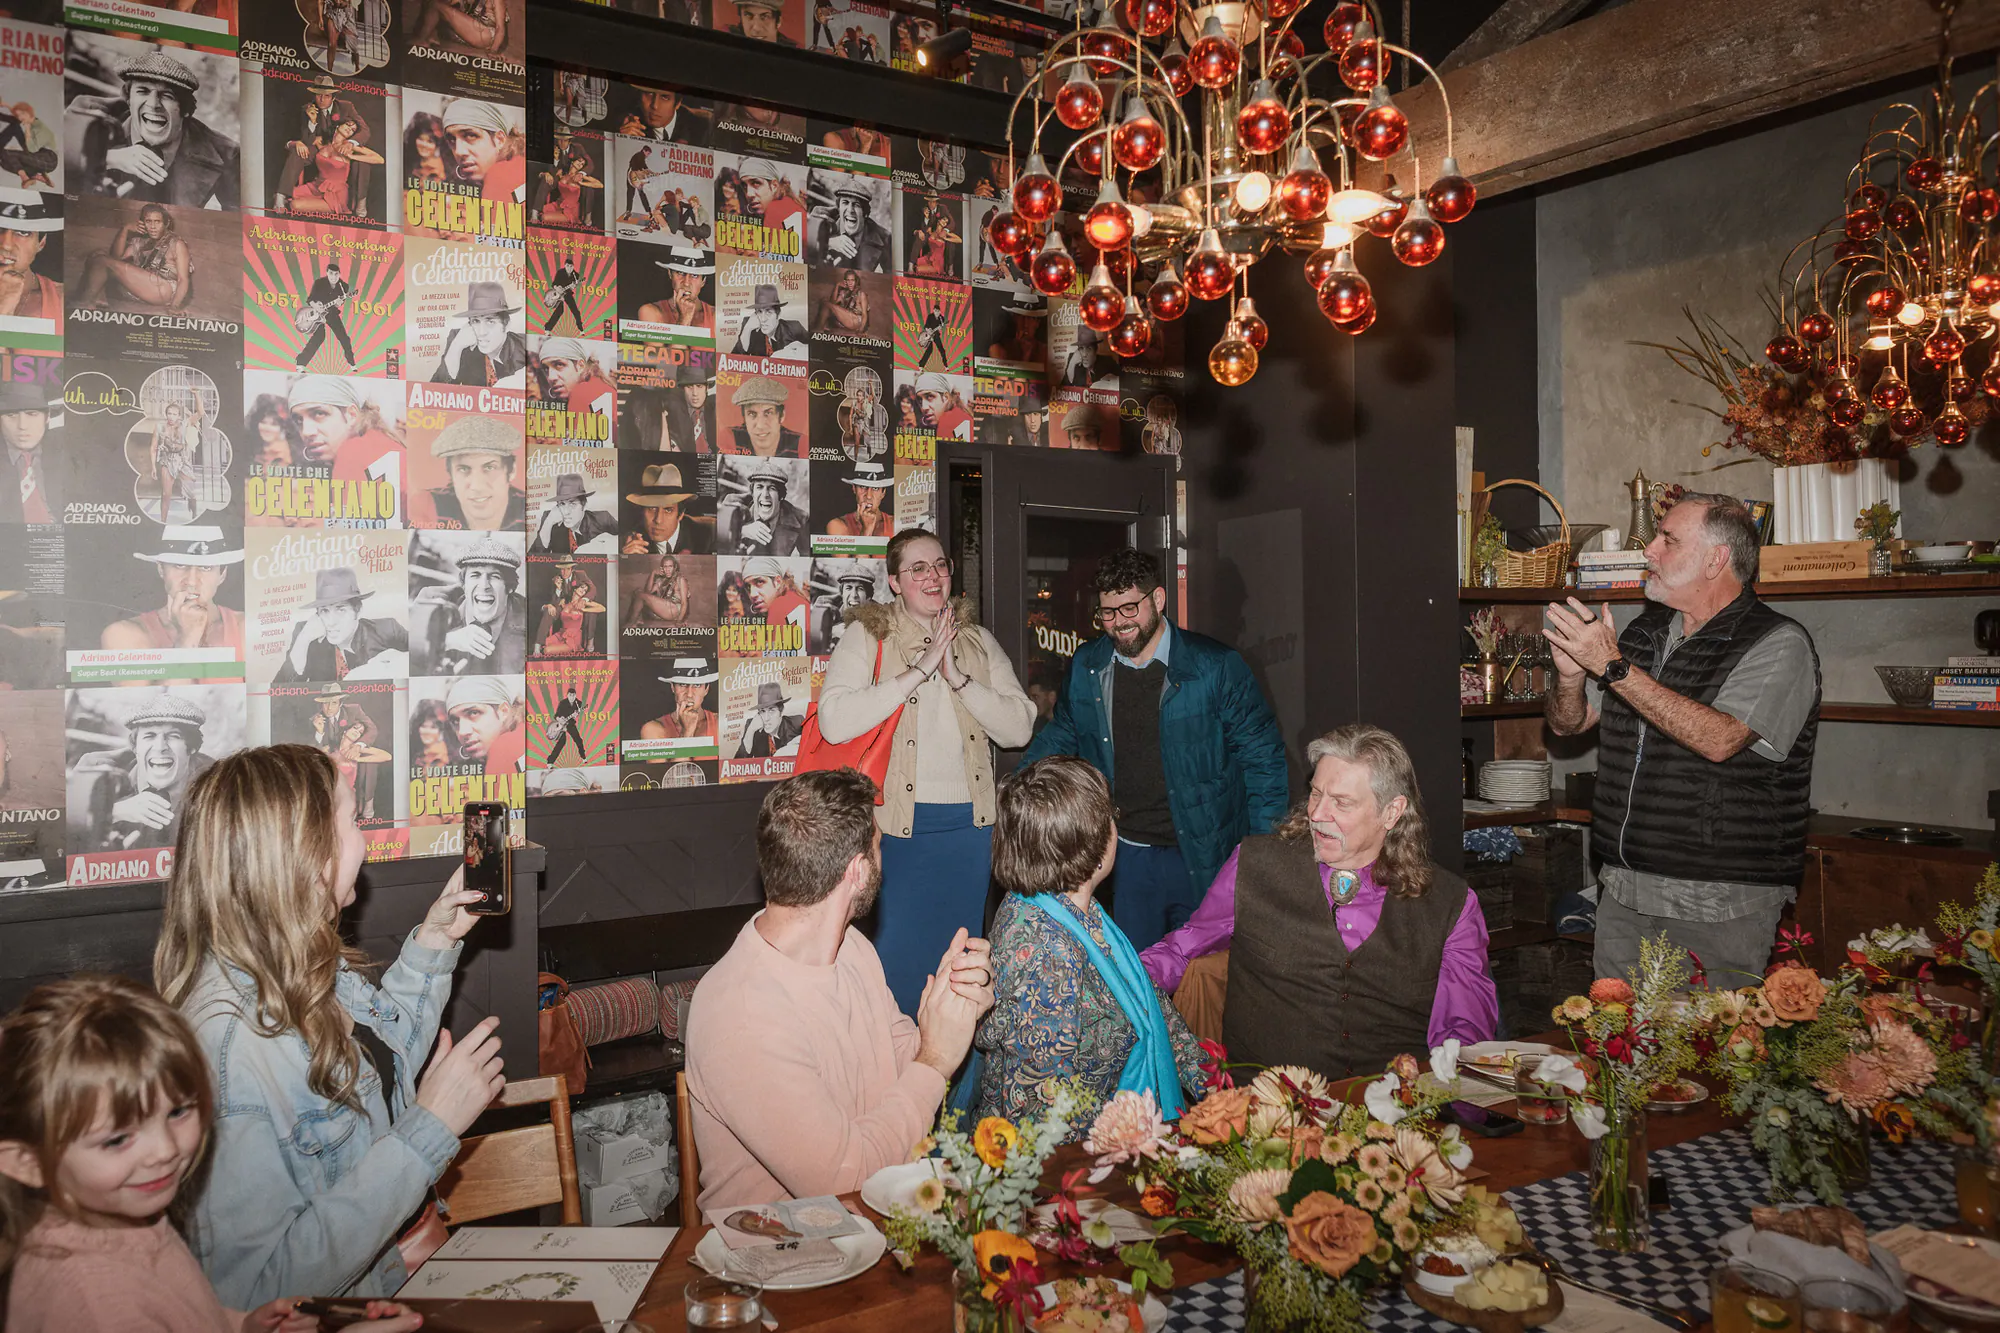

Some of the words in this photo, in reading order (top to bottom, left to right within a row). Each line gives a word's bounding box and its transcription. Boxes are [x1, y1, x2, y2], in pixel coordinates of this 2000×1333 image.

[111, 4, 156, 18] Celentano
[850, 1, 890, 20] CELENTANO
[71, 11, 91, 23] Super
[94, 15, 110, 25] Best
[112, 18, 160, 33] (Remastered)
[242, 40, 297, 57] ADRIANO
[0, 50, 64, 76] ENTANO
[240, 51, 310, 70] CELENTANO
[408, 45, 469, 64] ADRIANO
[472, 58, 526, 76] CELENTA
[261, 67, 302, 82] adriano
[339, 81, 389, 97] celentano
[718, 121, 756, 136] ADRIANO
[757, 129, 804, 144] CELENTANO
[669, 148, 714, 166] ADRIANO
[668, 160, 714, 179] CELENTANO
[892, 169, 919, 180] ADRIANO
[409, 177, 420, 189] LE
[422, 179, 455, 194] VOLTE
[458, 184, 479, 197] CHE
[891, 176, 926, 187] CELENTANO
[718, 212, 726, 220] LE
[727, 214, 747, 223] VOLTE
[749, 217, 762, 226] CHE
[249, 225, 317, 245] Adriano
[322, 234, 397, 254] Celentano
[562, 238, 611, 252] Celentano
[716, 220, 799, 256] CELENTANO
[257, 242, 306, 256] ITALIAN
[310, 248, 343, 259] ROCK
[360, 253, 391, 264] ROLL
[428, 246, 513, 270] Adriano
[412, 261, 507, 287] Celentano
[729, 259, 783, 275] Adriano
[719, 270, 779, 287] Celentano
[779, 272, 805, 285] Golden
[784, 280, 799, 291] Hits
[429, 293, 445, 301] MEZZA
[582, 284, 608, 298] 1961
[896, 281, 929, 294] Adriano
[931, 286, 968, 299] Celentano
[256, 291, 301, 309] 1957
[352, 300, 392, 317] 1961
[69, 309, 145, 327] ADRIANO
[149, 315, 239, 334] CELENTANO
[899, 321, 921, 333] 1957
[419, 333, 440, 341] PICCOLA
[946, 326, 966, 338] 1961
[811, 333, 847, 344] ADRIANO
[848, 336, 891, 348] CELENTANO
[619, 344, 714, 368] TECADISK
[619, 365, 665, 378] ADRIANO
[718, 354, 758, 373] ADRIANO
[761, 358, 806, 378] CELENTANO
[1122, 366, 1148, 376] ADRIANO
[1149, 368, 1184, 379] CELENTANO
[619, 376, 676, 388] CELENTANO
[716, 372, 742, 387] Soli
[409, 383, 473, 410] ADRIANO
[975, 395, 1010, 408] ADRIANO
[1050, 386, 1081, 402] ADRIANO
[1082, 390, 1118, 406] CELENTANO
[551, 402, 566, 411] CHE
[974, 404, 1019, 417] CELENTANO
[1049, 401, 1068, 416] Soli
[407, 409, 446, 430] Soli
[527, 409, 609, 441] ELENTANO
[896, 427, 903, 435] LE
[923, 429, 935, 437] CHE
[527, 449, 590, 467] Adriano
[809, 454, 846, 463] CELENTANO
[810, 447, 839, 456] ADRIANO
[250, 464, 262, 476] LE
[267, 465, 302, 478] VOLTE
[307, 466, 329, 478] CHE
[584, 458, 615, 473] Golden
[591, 468, 608, 479] Hits
[249, 477, 395, 520] CELENTANO
[65, 503, 127, 514] ADRIANO
[64, 513, 141, 525] CELENTANO
[271, 532, 366, 561] Adriano
[359, 544, 404, 565] Golden
[252, 551, 359, 580] Celentano
[367, 558, 393, 574] Hits
[1783, 561, 1856, 574] Collemattoni
[272, 585, 291, 594] MEZZA
[1611, 580, 1640, 589] ZAHAV
[721, 617, 728, 625] LE
[730, 617, 749, 625] VOLTE
[752, 616, 766, 625] CHE
[261, 628, 285, 638] PICCOLA
[622, 628, 663, 637] ADRIANO
[665, 627, 715, 637] CELENTANO
[720, 625, 803, 651] CELENTANO
[79, 653, 115, 663] Adriano
[118, 652, 162, 662] Celentano
[77, 669, 99, 679] Super
[100, 668, 116, 677] Best
[118, 666, 166, 677] (Remastered)
[564, 666, 614, 678] Celentano
[733, 659, 785, 678] Adriano
[723, 671, 782, 692] Celentano
[782, 666, 810, 681] Golden
[788, 675, 802, 687] Hits
[268, 685, 309, 698] adriano
[346, 683, 397, 695] celentano
[585, 710, 611, 722] 1961
[411, 766, 423, 778] LE
[426, 765, 458, 777] VOLTE
[462, 763, 483, 775] CHE
[721, 761, 761, 778] ADRIANO
[69, 856, 150, 885] ADRIANO
